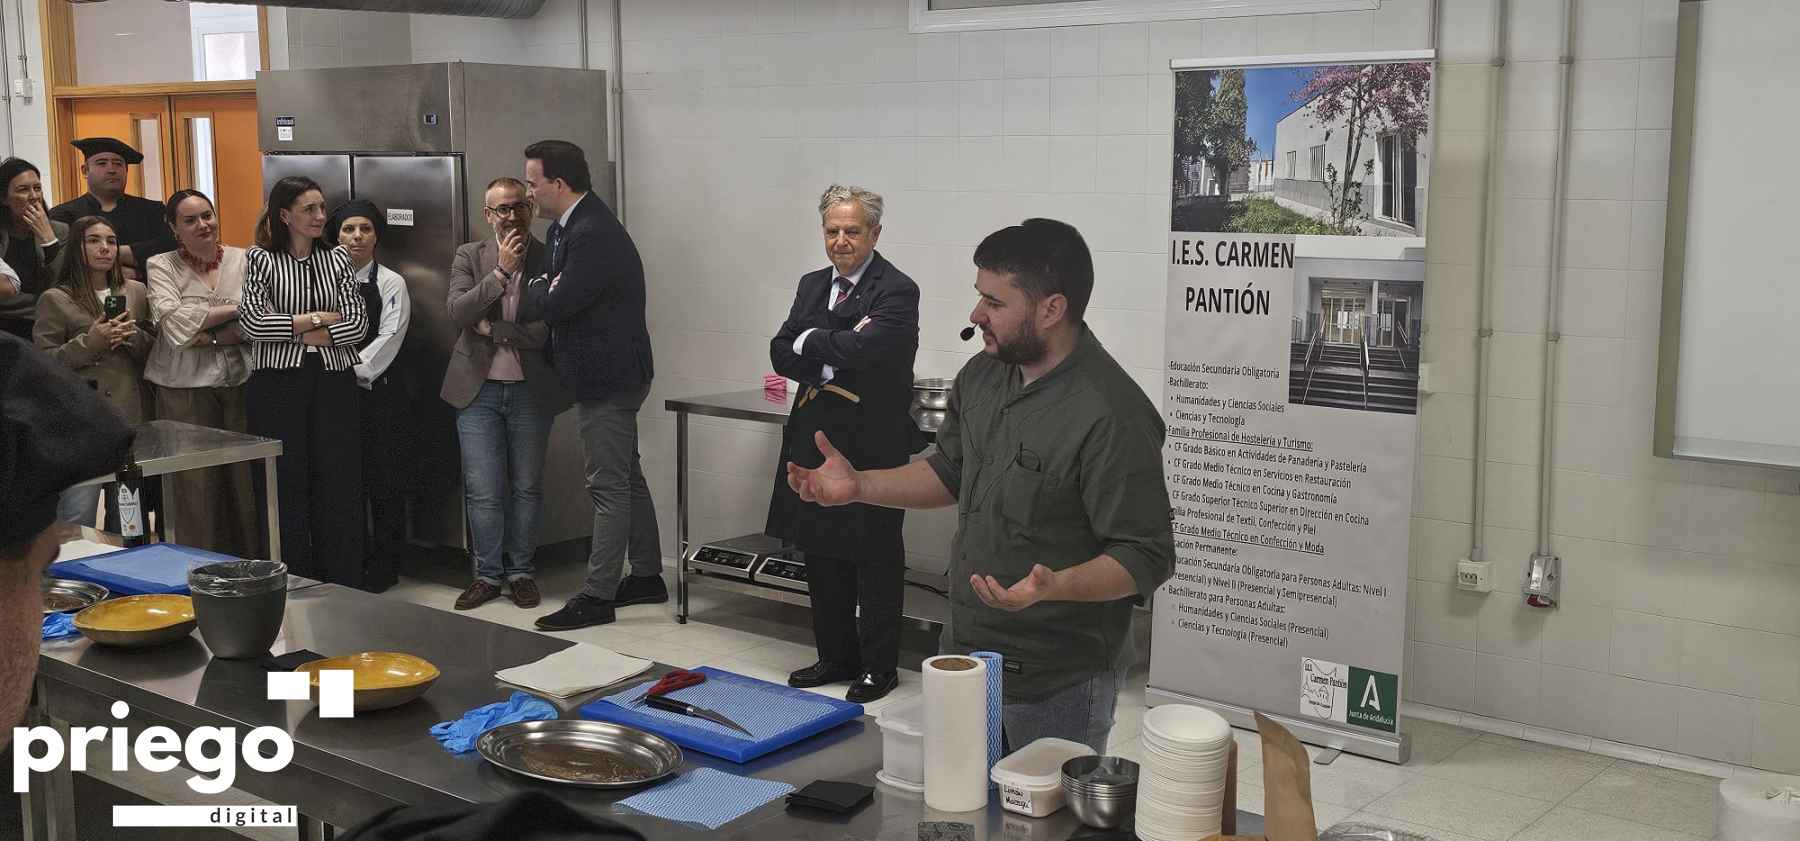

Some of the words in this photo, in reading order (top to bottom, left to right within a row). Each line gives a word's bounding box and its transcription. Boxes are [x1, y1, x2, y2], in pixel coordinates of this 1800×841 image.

[1172, 239, 1208, 266] I.E.S.
[1215, 240, 1294, 269] CARMEN
[1185, 282, 1270, 315] PANTIÓN
[1201, 363, 1240, 375] Secundaria
[1242, 366, 1280, 380] Obligatoria
[1175, 409, 1201, 422] Ciencias
[1202, 414, 1207, 424] y
[1208, 413, 1245, 428] Tecnología
[1176, 394, 1221, 407] Humanidades
[1222, 400, 1227, 410] y
[1227, 398, 1257, 410] Ciencias
[1257, 400, 1285, 413] Sociales
[1191, 427, 1230, 441] Profesional
[1231, 431, 1240, 442] de
[1241, 432, 1276, 447] Hostelería
[1277, 438, 1282, 448] y
[1283, 437, 1313, 450] Turismo:
[1174, 442, 1182, 451] CF
[1183, 442, 1202, 454] Grado
[1227, 449, 1236, 458] en
[1237, 449, 1277, 463] Actividades
[1278, 453, 1286, 464] de
[1324, 460, 1330, 472] y
[1331, 459, 1367, 473] Pastelería
[1173, 458, 1181, 468] CF
[1182, 459, 1202, 471] Grado
[1203, 461, 1225, 473] Medio
[1226, 464, 1252, 477] Técnico
[1253, 468, 1262, 478] en
[1263, 468, 1293, 482] Servicios
[1294, 474, 1303, 484] en
[1304, 473, 1352, 489] Restauración
[1172, 474, 1180, 484] CF
[1181, 475, 1201, 487] Grado
[1202, 477, 1223, 489] Medio
[1224, 480, 1251, 493] Técnico
[1252, 484, 1261, 494] en
[1262, 484, 1285, 498] Cocina
[1286, 489, 1291, 500] y
[1291, 488, 1338, 504] Gastronomía
[1172, 490, 1180, 500] CF
[1181, 491, 1200, 503] Grado
[1201, 493, 1230, 507] Superior
[1259, 501, 1289, 515] Superior
[1289, 507, 1298, 517] en
[1299, 506, 1333, 521] Dirección
[1334, 513, 1344, 522] en
[1345, 513, 1369, 526] Cocina
[1186, 508, 1225, 522] Profesional
[1226, 513, 1235, 523] de
[1258, 517, 1296, 533] Confección
[1297, 525, 1302, 536] y
[1303, 523, 1316, 535] Piel
[1180, 523, 1200, 535] Grado
[1201, 526, 1221, 538] Medio
[1222, 529, 1249, 542] Técnico
[1249, 533, 1259, 543] en
[1260, 534, 1298, 550] Confección
[1299, 541, 1304, 552] y
[1304, 540, 1325, 553] Moda
[1195, 541, 1238, 557] Permanente:
[1203, 558, 1240, 574] Secundaria
[1241, 564, 1281, 580] Obligatoria
[1281, 571, 1298, 583] para
[1298, 573, 1331, 589] Personas
[1363, 583, 1383, 597] Nivel
[1207, 576, 1212, 588] y
[1213, 574, 1231, 588] Nivel
[1276, 588, 1282, 600] y
[1168, 585, 1208, 601] Bachillerato
[1208, 592, 1224, 604] para
[1225, 594, 1257, 610] Personas
[1178, 603, 1224, 620] Humanidades
[1224, 611, 1230, 623] y
[1230, 612, 1258, 627] Ciencias
[1259, 616, 1287, 632] Sociales
[1288, 622, 1329, 641] (Presencial)
[1178, 618, 1206, 632] Ciencias
[1205, 623, 1211, 635] y
[1248, 629, 1289, 649] (Presencial)
